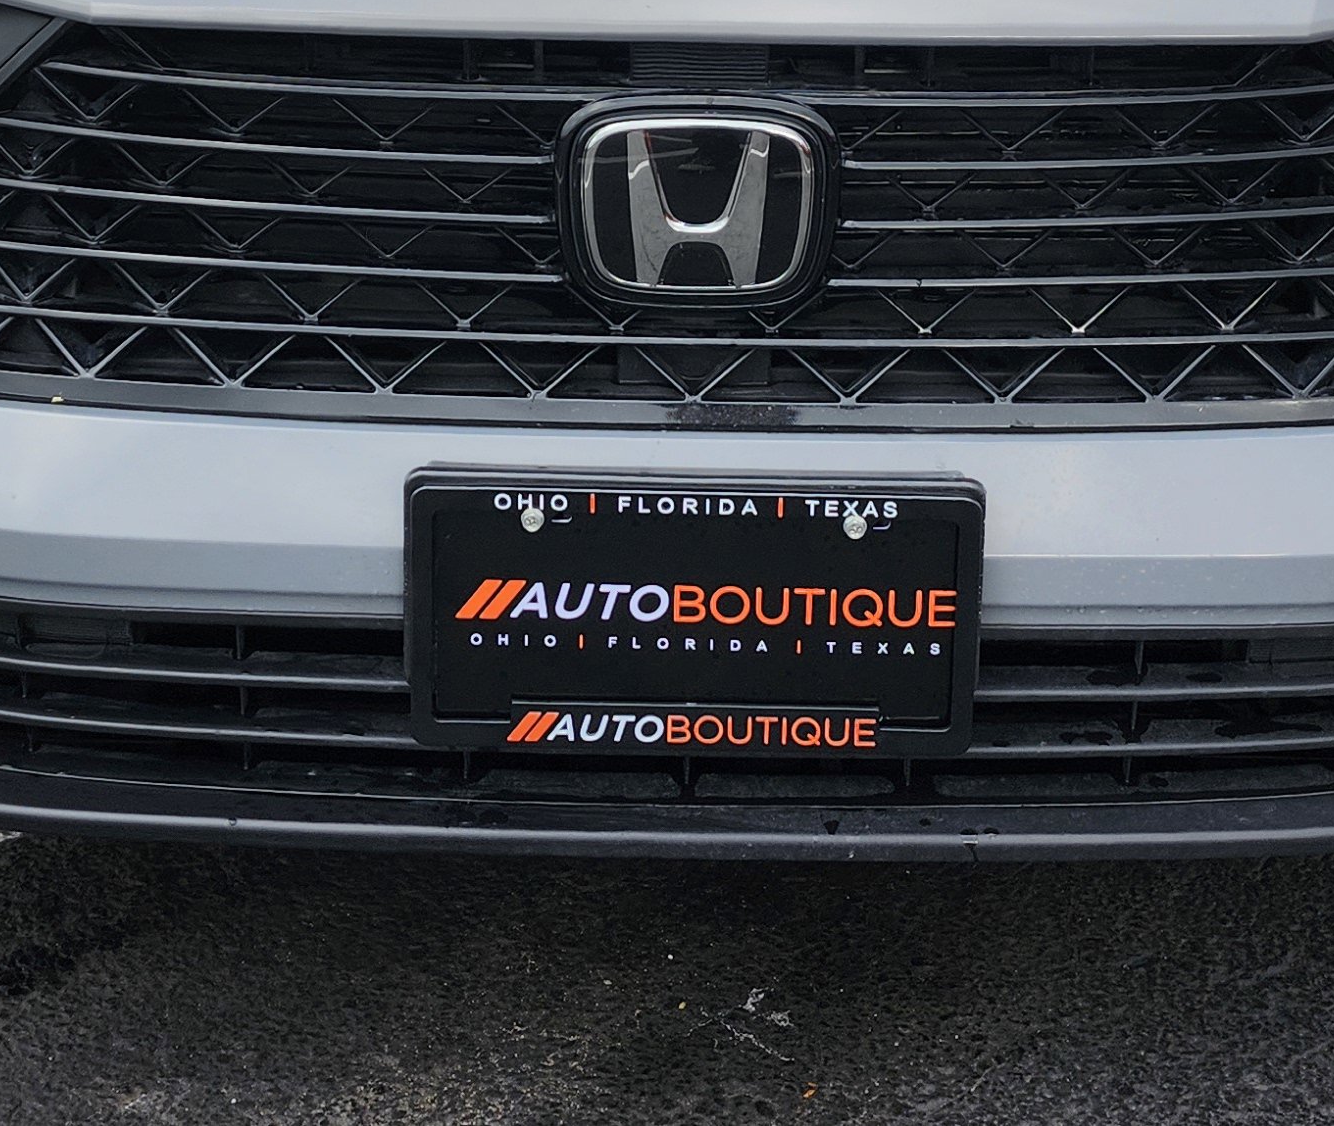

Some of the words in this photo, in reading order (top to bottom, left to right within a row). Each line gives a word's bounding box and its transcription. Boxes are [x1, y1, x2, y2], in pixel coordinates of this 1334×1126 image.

[493, 492, 569, 511] OHIO
[617, 495, 759, 516] FLORIDA
[805, 499, 899, 519] TEXAS
[470, 632, 557, 648] OHIO
[607, 636, 768, 653] FLORIDA
[827, 641, 942, 656] TEXAS
